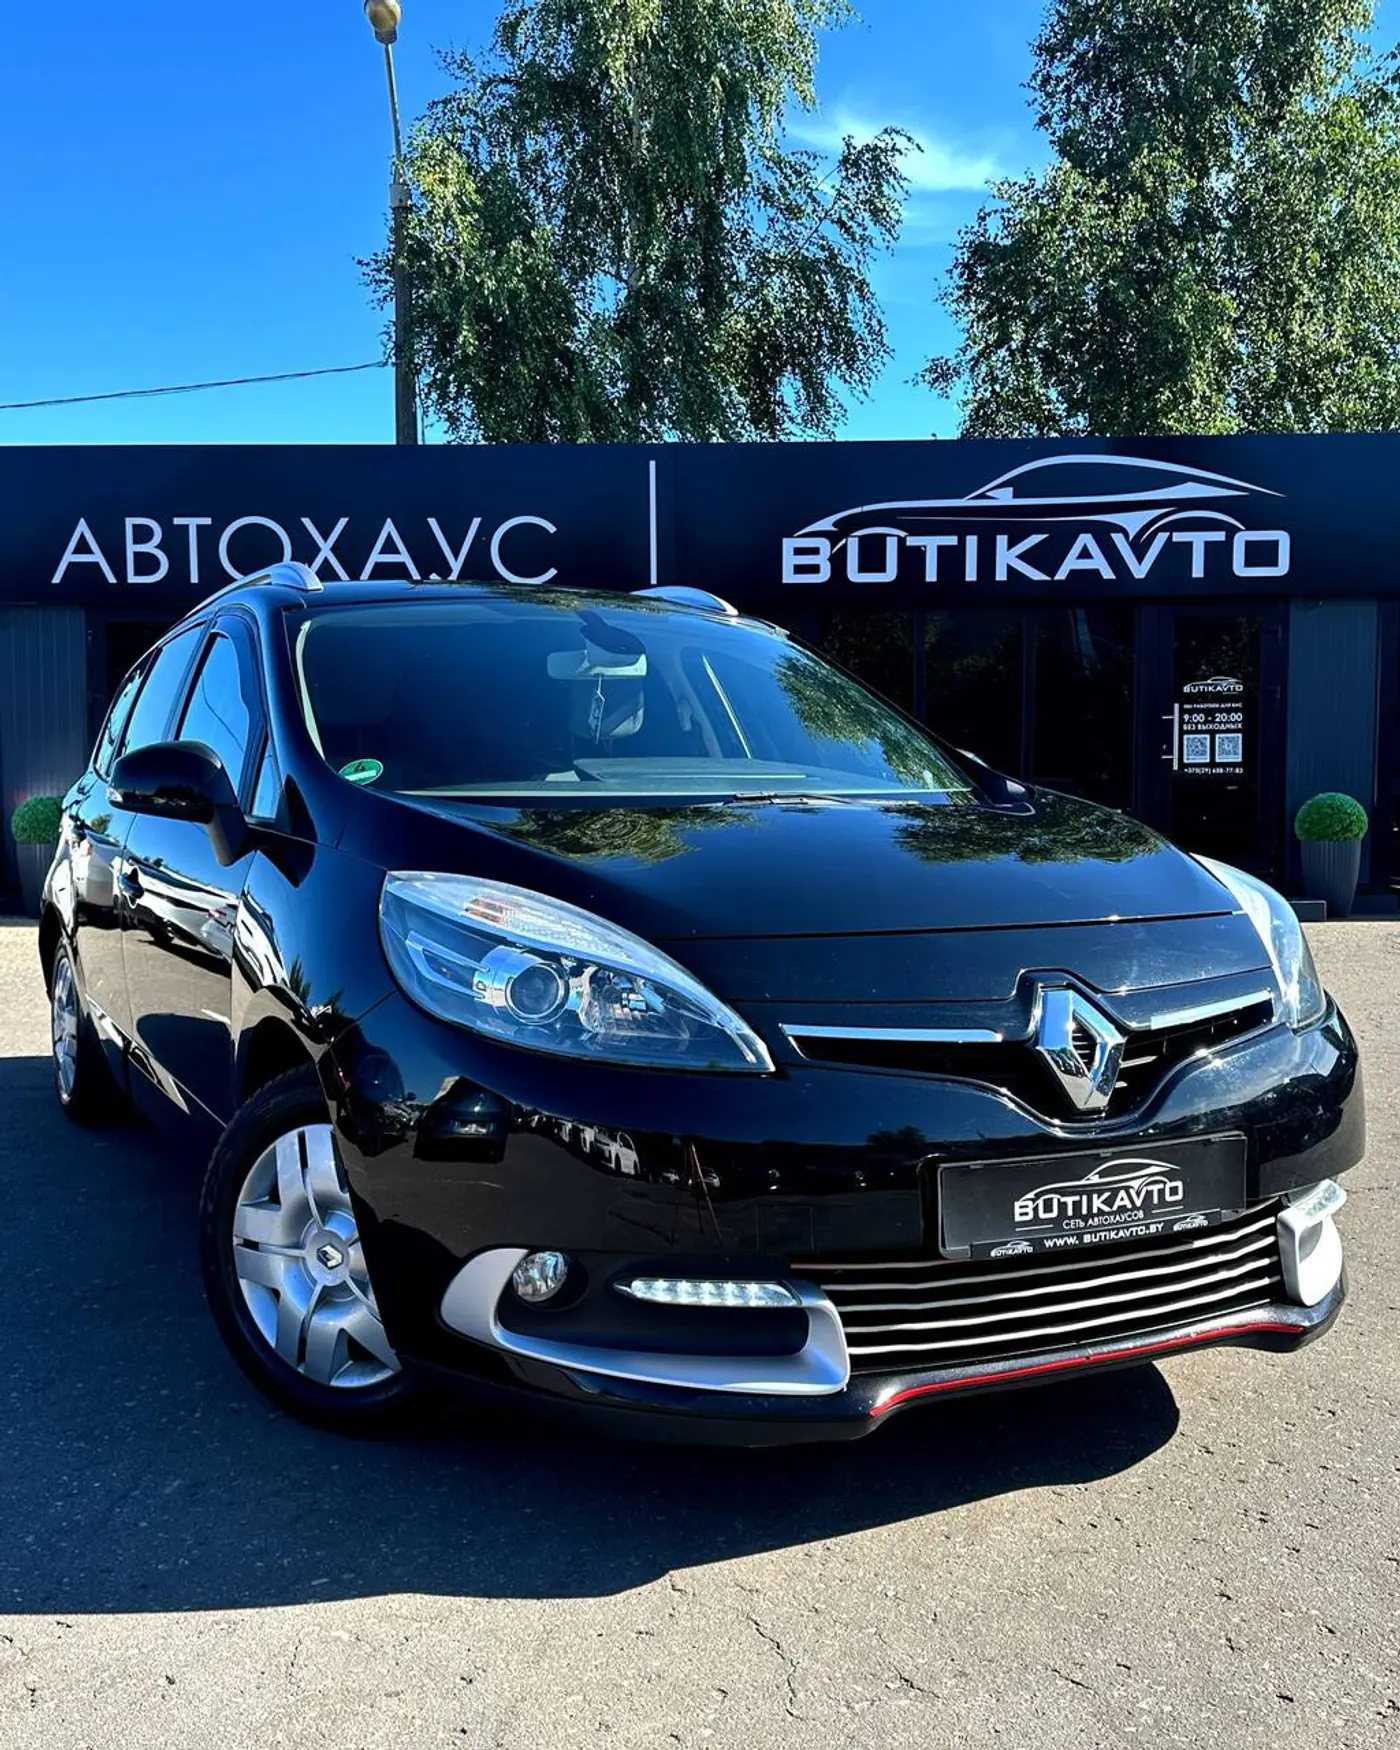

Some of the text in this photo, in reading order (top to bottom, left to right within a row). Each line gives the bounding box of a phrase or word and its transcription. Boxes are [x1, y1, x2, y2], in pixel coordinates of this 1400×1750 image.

[51, 515, 558, 584] АВТОХАУС
[782, 529, 1291, 584] BUTIKAVTO
[1183, 684, 1243, 693] BUTIKAVTO
[1183, 713, 1205, 723] 9:00
[1214, 712, 1243, 722] 20:00
[1197, 722, 1243, 730] ВЫХОДНЫХ
[1014, 1180, 1184, 1222] BUTIKAVTO
[1062, 1209, 1145, 1230] СЕТЬ АВТОХАУСОВ
[1043, 1221, 1165, 1249] WWW. BUTIKAVTO.BY
